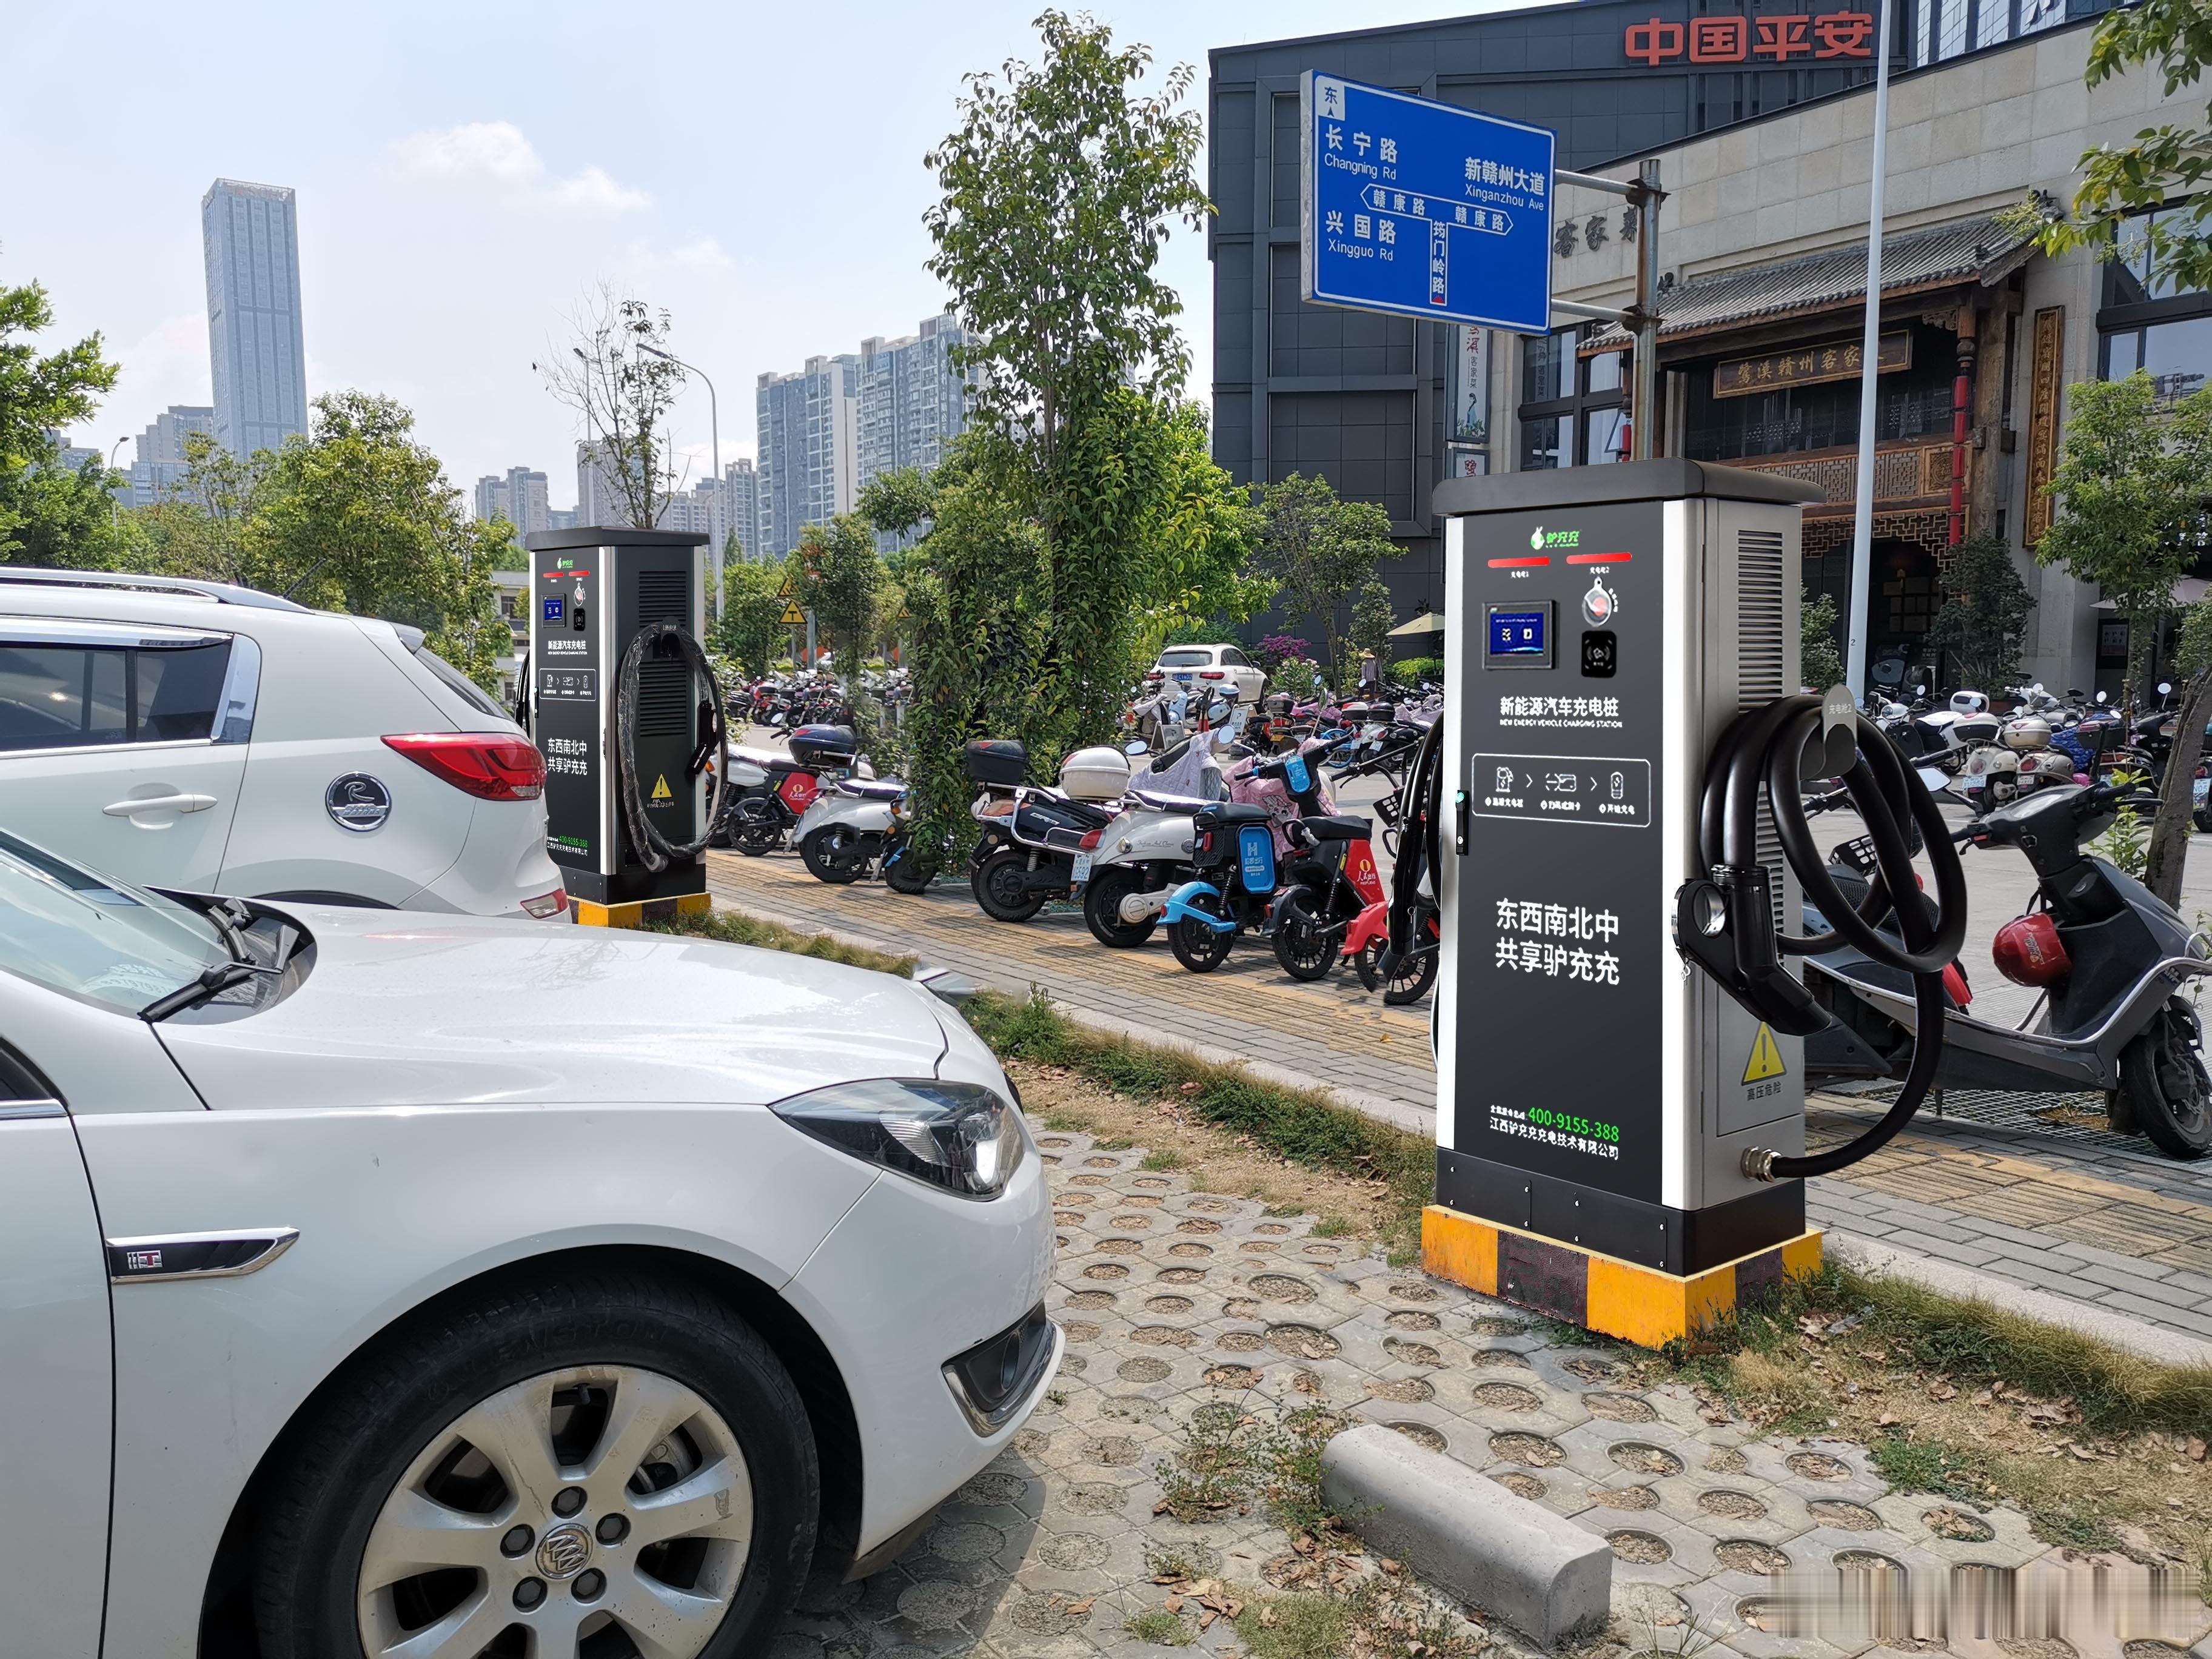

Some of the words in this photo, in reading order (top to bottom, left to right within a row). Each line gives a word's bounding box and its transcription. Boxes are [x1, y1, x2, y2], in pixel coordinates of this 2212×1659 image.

[1625, 10, 1872, 66] 中国平安
[1324, 86, 1338, 104] 东
[1326, 124, 1397, 164] 长宁路
[1324, 153, 1378, 178] Changning
[1383, 166, 1396, 180] Rd
[1465, 157, 1544, 196] 新赣州大道
[1373, 189, 1426, 215] 赣康路
[1465, 184, 1524, 207] Xinganzhou
[1528, 196, 1544, 210] Ave
[1326, 210, 1396, 244] 兴国路
[1455, 206, 1504, 232] 赣康路
[1328, 239, 1374, 259] Xingguo
[1379, 247, 1393, 261] Rd
[1432, 221, 1446, 295] 筠门岭路
[548, 640, 586, 651] 新能源汽车充电桩
[1500, 695, 1619, 717] 新能源汽车充电桩
[548, 737, 587, 756] 东西南北中
[548, 756, 588, 776] 共享驴充充
[1496, 897, 1619, 943] 东西南北中
[1495, 935, 1620, 985] 共享驴充充
